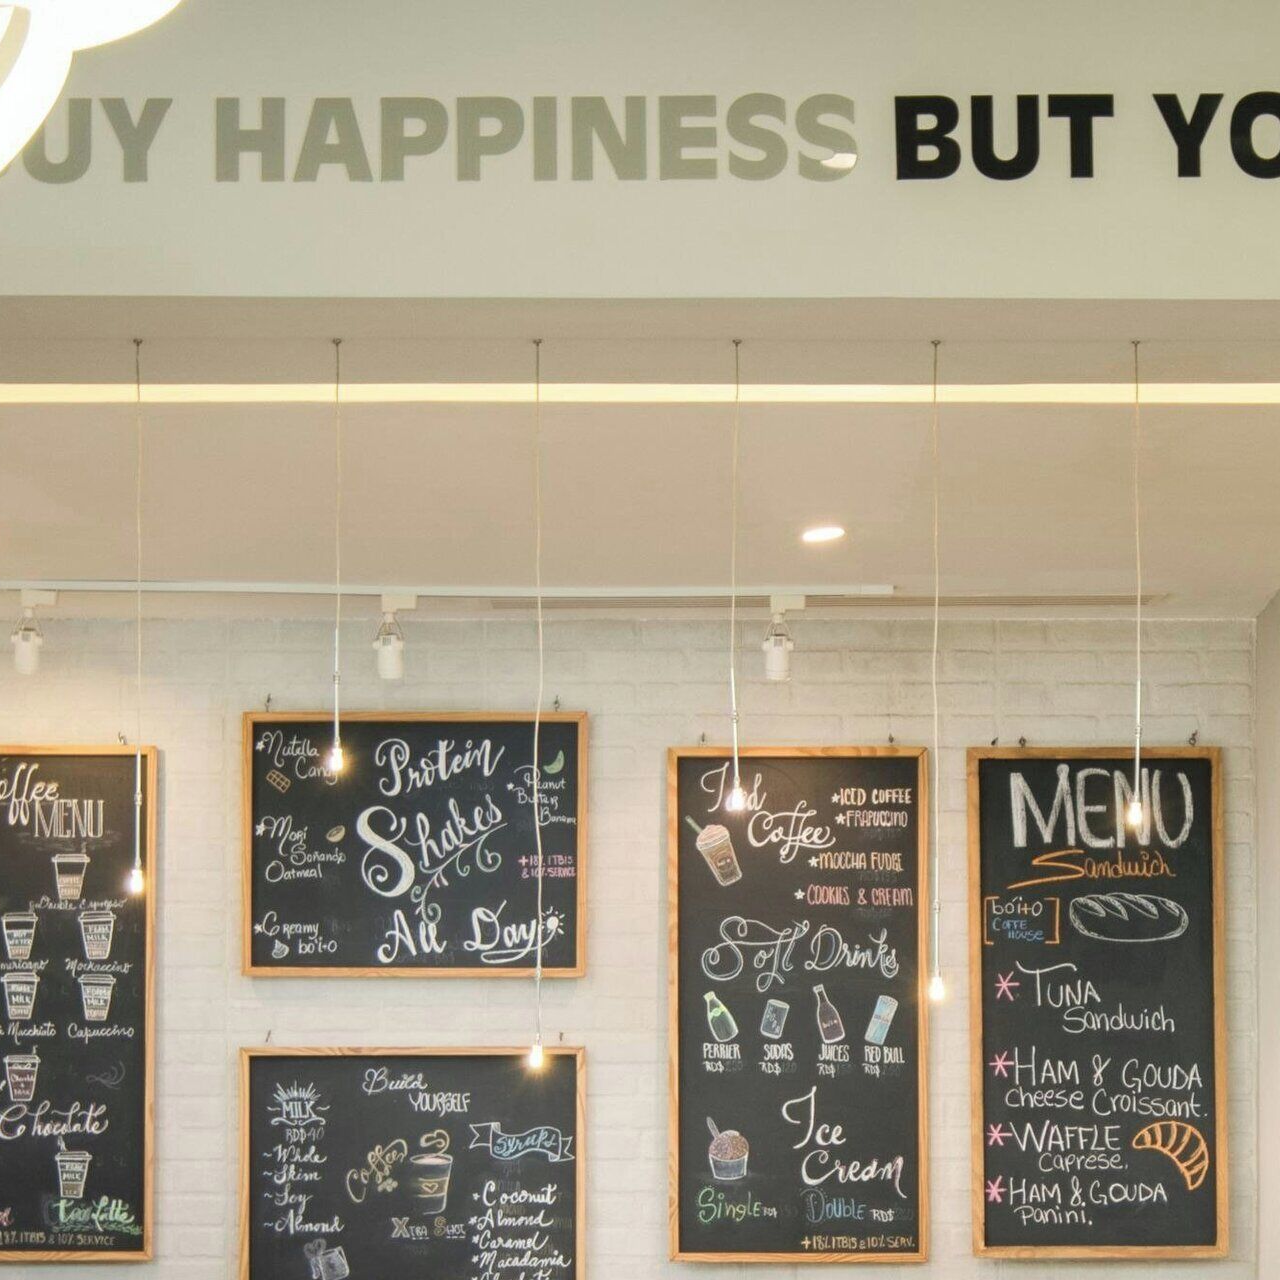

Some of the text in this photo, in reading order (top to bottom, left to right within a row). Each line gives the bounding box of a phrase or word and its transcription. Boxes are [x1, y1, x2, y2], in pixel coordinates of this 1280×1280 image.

[216, 95, 858, 184] HAPPINESS
[894, 93, 1115, 181] BUT
[262, 730, 320, 768] Nutella
[375, 738, 505, 797] Protein
[840, 787, 912, 806] ICED COFFEE
[1010, 763, 1194, 848] MENU
[34, 799, 105, 838] MENU
[846, 810, 908, 828] FRAPUCCINO
[747, 800, 836, 864] Coffee
[357, 794, 503, 898] Shakes
[266, 860, 322, 882] Oatmeal
[547, 867, 576, 878] SERVICE
[871, 852, 904, 872] FUDGE
[1007, 850, 1176, 889] Sandwich
[806, 884, 914, 906] COOKIES & CREAM
[263, 911, 320, 940] Creamy
[463, 900, 550, 964] Day
[701, 915, 900, 992] Soft Drinks
[1016, 960, 1101, 1007] TUNA
[1062, 1005, 1176, 1033] Sandwich
[67, 1023, 135, 1044] Capuccino
[702, 1043, 741, 1060] PERRIER
[763, 1043, 794, 1061] SODAS
[818, 1043, 850, 1062] JUICES
[864, 1045, 905, 1064] RED BULL
[362, 1066, 428, 1095] Build
[1014, 1046, 1203, 1092] HAM & GOUDA
[282, 1101, 317, 1118] MILK
[408, 1092, 470, 1117] YOURSELF
[1092, 1088, 1208, 1118] Croissant.
[781, 1085, 847, 1149] Ice
[1009, 1120, 1122, 1152] WAFFLE
[273, 1144, 327, 1163] Whole
[273, 1163, 322, 1185] Skim
[801, 1149, 908, 1199] Cream
[274, 1184, 313, 1215] Soy
[483, 1180, 557, 1206] Coconut
[1010, 1177, 1062, 1205] HAM
[1089, 1180, 1168, 1205] GOUDA
[275, 1209, 344, 1235] Almond
[476, 1208, 554, 1231] Almond
[76, 1233, 116, 1246] SERVICE
[479, 1230, 549, 1250] Caramel
[832, 1235, 857, 1250] ITBIS
[887, 1235, 916, 1248] SERV.
[480, 1250, 571, 1274] Macadamia
